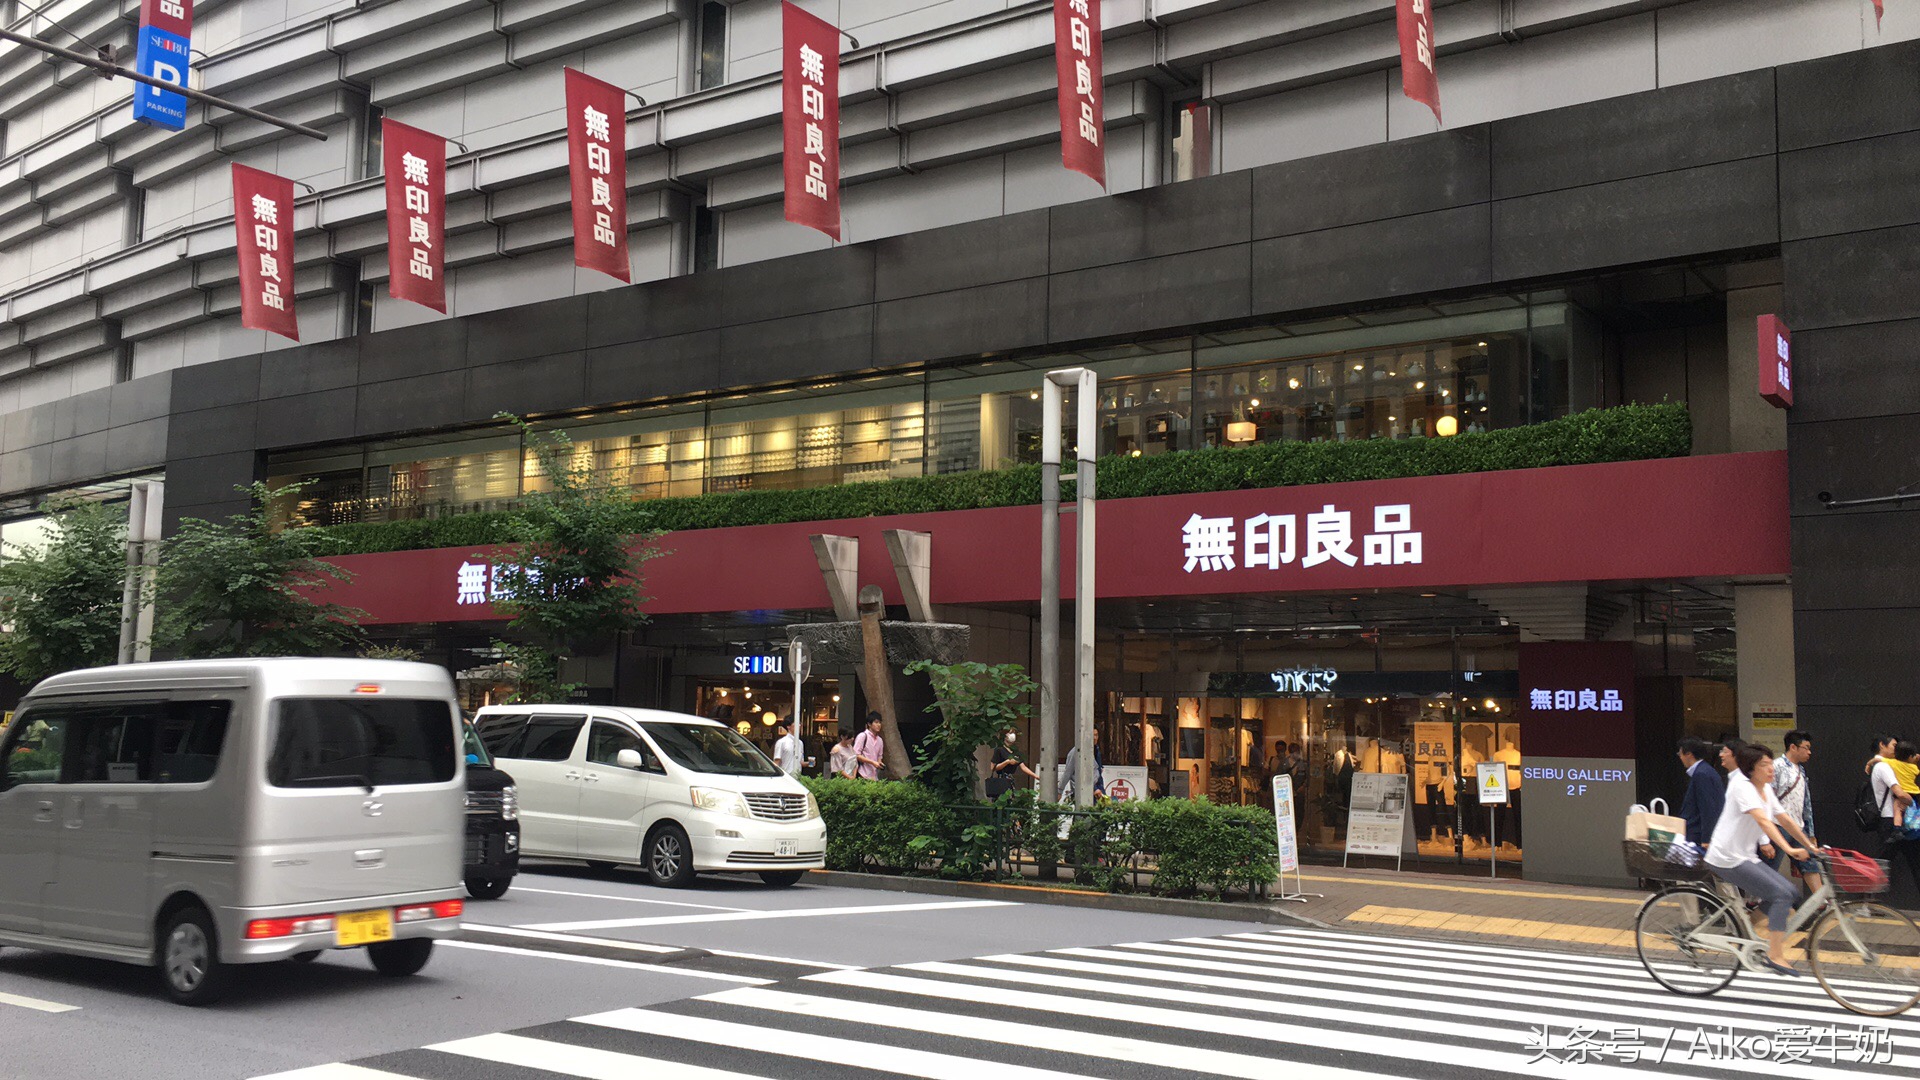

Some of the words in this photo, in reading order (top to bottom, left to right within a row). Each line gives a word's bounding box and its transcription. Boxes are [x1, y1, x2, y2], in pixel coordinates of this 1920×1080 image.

[151, 35, 187, 56] SEIBU
[152, 60, 181, 97] P
[146, 101, 183, 118] PARKING
[800, 43, 827, 200] 無印良品
[584, 105, 615, 247] 無印良品
[403, 152, 432, 280] 無印良品
[252, 194, 284, 311] 無印良品
[1182, 504, 1422, 573] 無印良品
[734, 656, 782, 673] SEIBU
[1530, 689, 1623, 711] 無印良品
[1524, 767, 1564, 780] SEIBU
[1567, 768, 1632, 782] GALLERY
